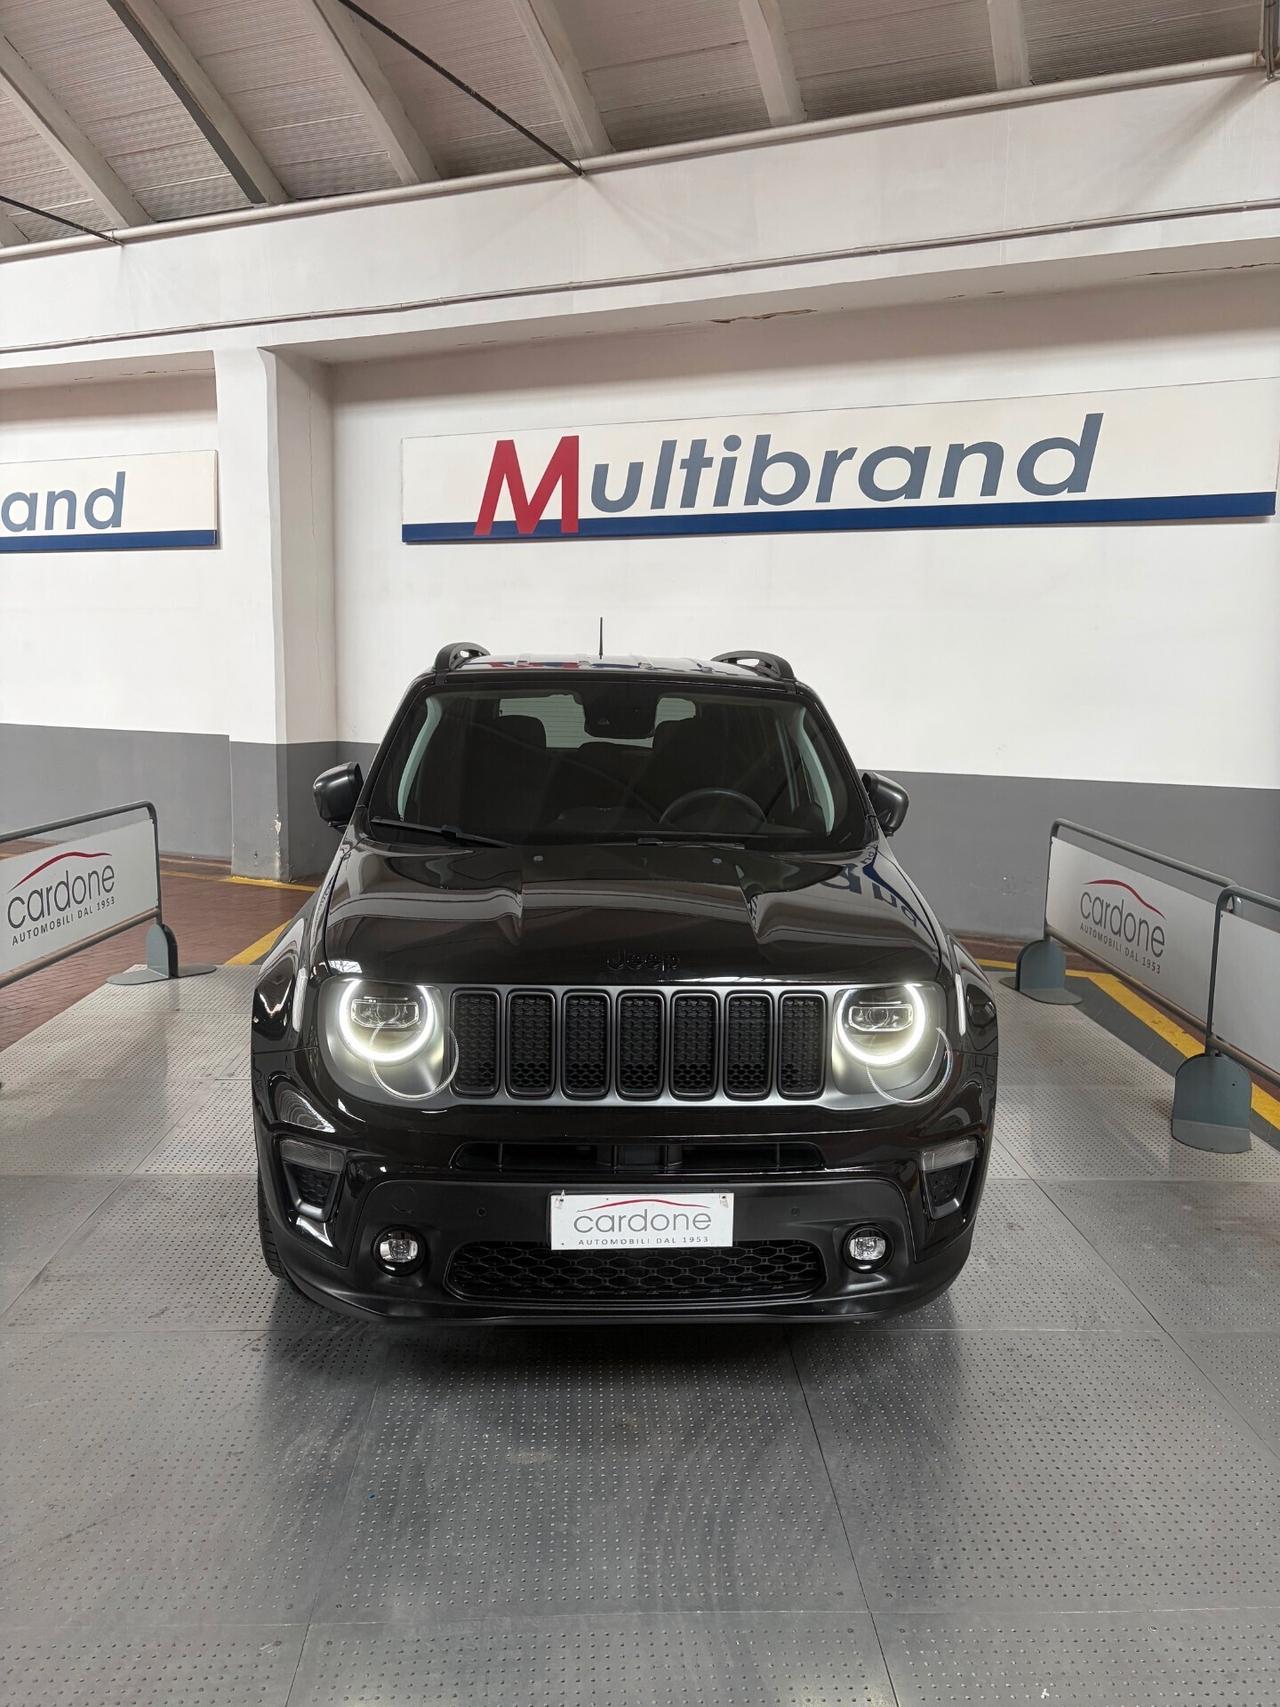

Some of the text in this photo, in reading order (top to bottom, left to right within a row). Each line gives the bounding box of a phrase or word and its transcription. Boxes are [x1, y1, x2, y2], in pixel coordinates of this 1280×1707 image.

[474, 412, 1104, 536] Multibrand
[7, 865, 115, 929] cardone
[12, 896, 115, 946] AUTOMOBILI DAL 1953
[1080, 892, 1165, 958] cardone
[1080, 923, 1161, 974] AUTOMOBILI DAL 1953
[574, 1208, 711, 1233] cardone
[578, 1238, 650, 1246] AUTOMOBILI
[682, 1235, 709, 1243] 1953
